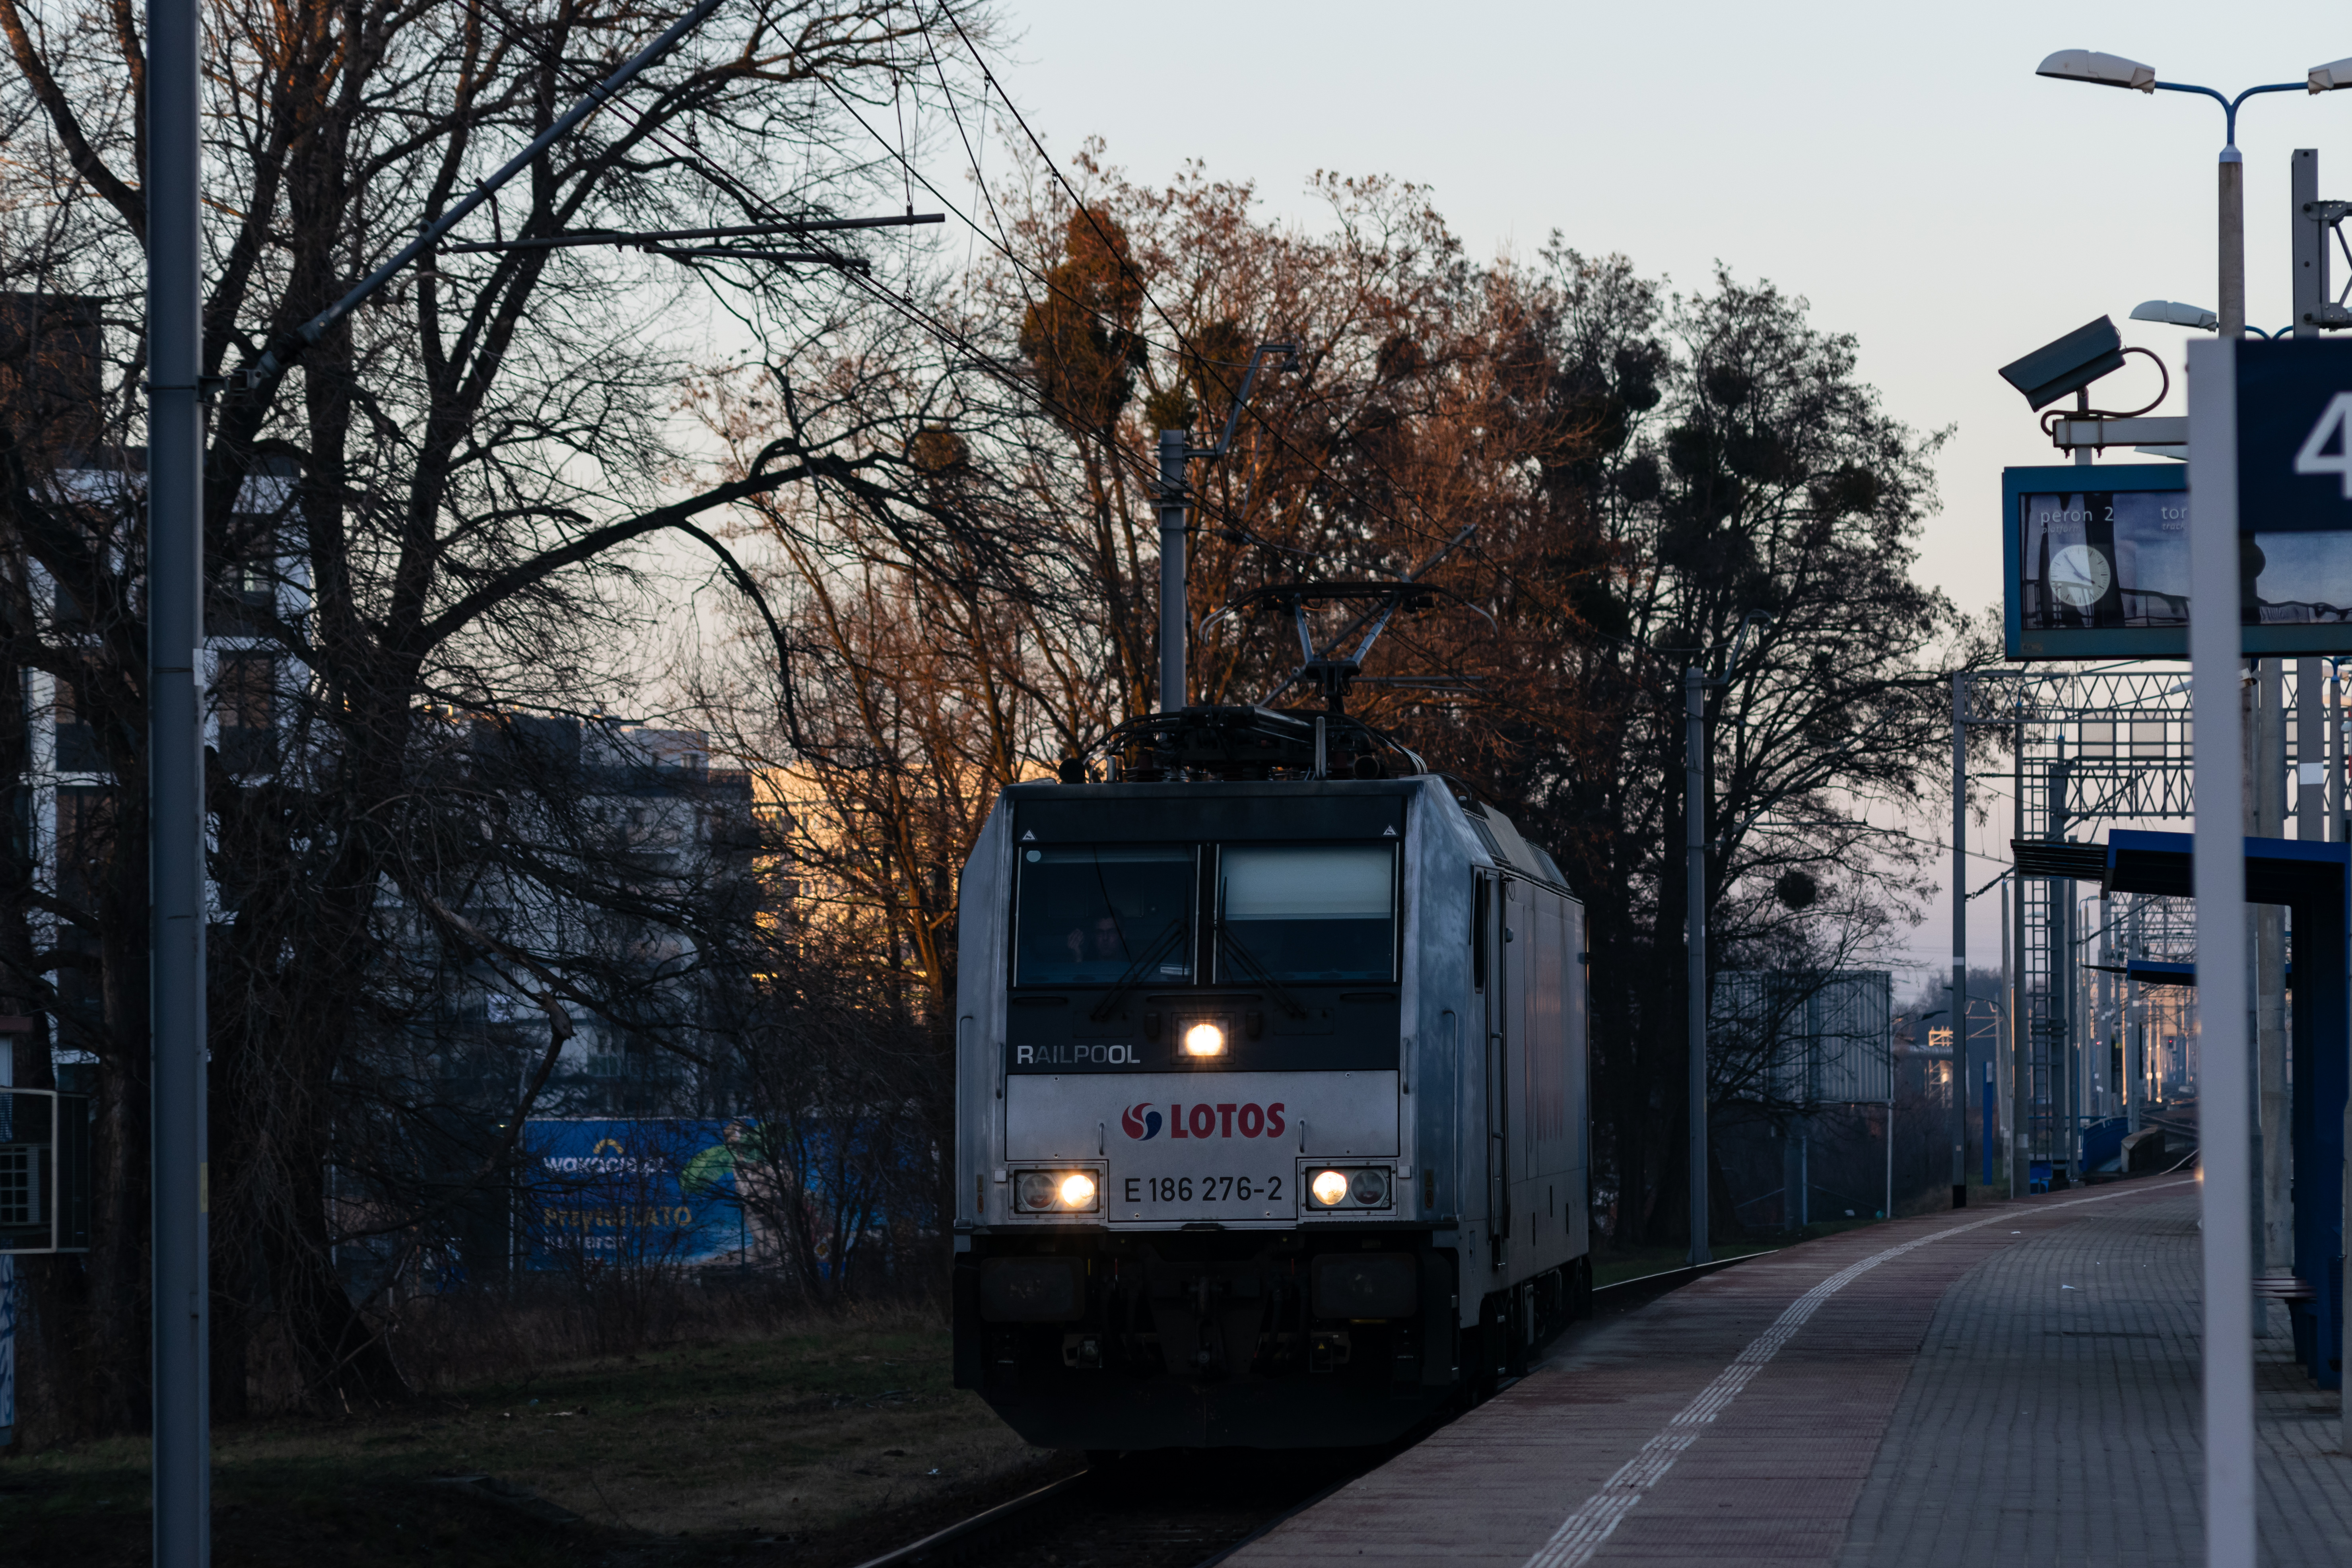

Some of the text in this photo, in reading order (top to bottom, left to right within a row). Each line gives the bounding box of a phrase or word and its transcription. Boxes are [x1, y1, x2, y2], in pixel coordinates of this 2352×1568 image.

[2294, 391, 2352, 500] 4
[2040, 507, 2114, 525] peron 2
[2161, 507, 2187, 520] tor
[2041, 525, 2081, 534] platform
[1017, 1045, 1140, 1064] RAILPOOL
[1171, 1103, 1285, 1139] LOTOS
[1125, 1176, 1282, 1202] E 186 276-2
[632, 1207, 692, 1226] LATO
